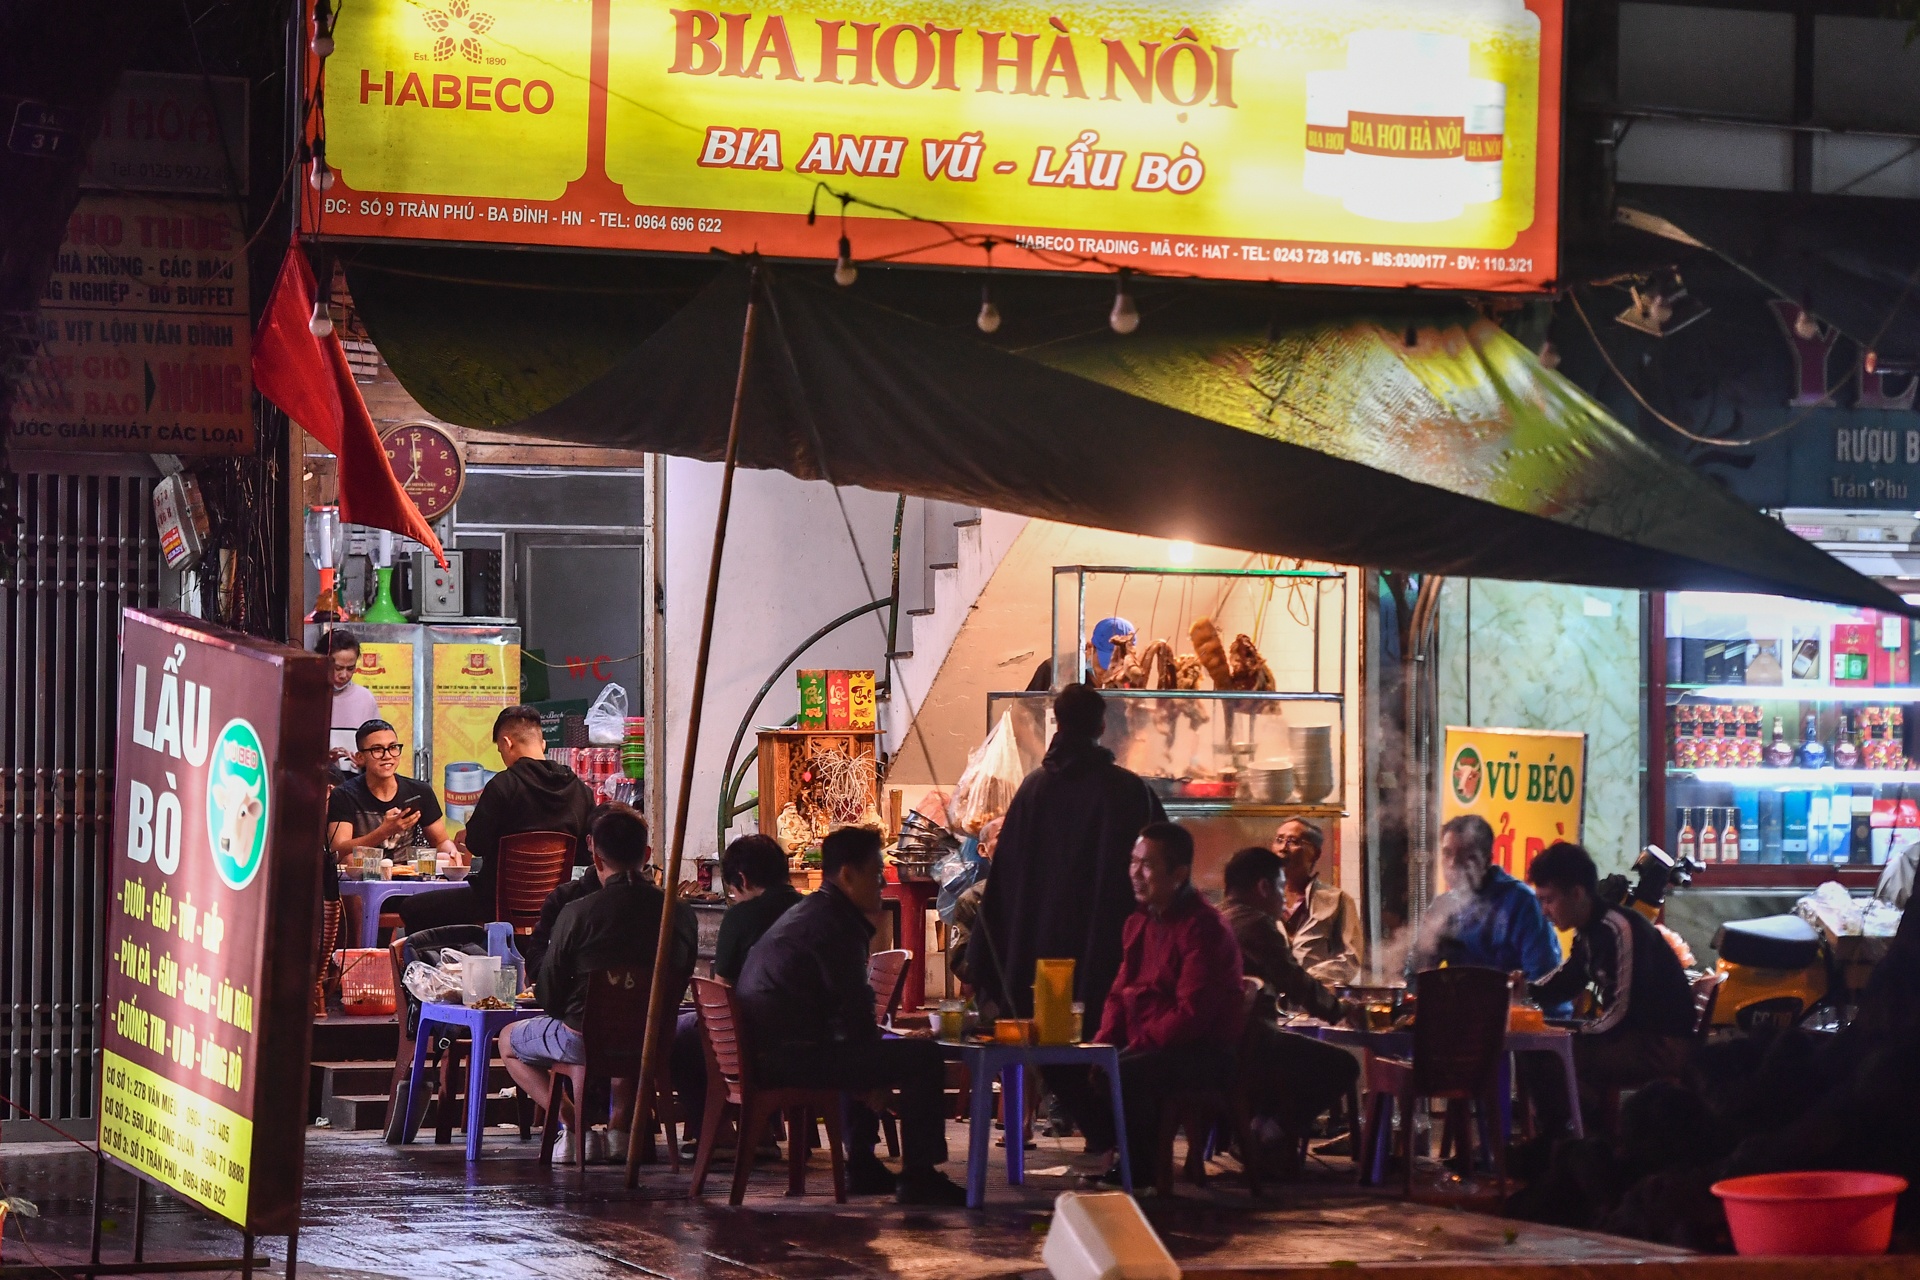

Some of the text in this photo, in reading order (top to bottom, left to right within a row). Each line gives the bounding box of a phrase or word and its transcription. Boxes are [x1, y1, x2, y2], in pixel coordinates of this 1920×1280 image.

[414, 52, 507, 67] Est. 1890
[668, 8, 1240, 123] BIA HƠI HÀ NỘI
[359, 70, 555, 115] HABECO
[1308, 130, 1345, 151] BIA HƠI
[1350, 120, 1461, 155] BIA HƠI HÀ NỘI
[1467, 136, 1483, 157] HÀ
[699, 126, 783, 169] BIA
[800, 131, 907, 175] ANH
[922, 131, 986, 180] VŨ
[1029, 130, 1125, 191] LẨU
[1133, 142, 1205, 194] BÒ
[70, 212, 233, 251] HO THUÊ
[325, 198, 351, 214] ĐC:
[359, 197, 382, 216] SỐ
[386, 202, 394, 216] 9
[398, 200, 439, 219] TRẦN
[443, 202, 474, 220] PHÚ
[487, 207, 509, 221] BA
[512, 205, 548, 223] ĐÌNH
[561, 211, 582, 225] HN
[599, 212, 630, 228] TEL:
[635, 214, 666, 229] 0964
[670, 216, 694, 231] 696
[698, 218, 722, 233] 622
[160, 255, 192, 278] CÁC
[1015, 234, 1074, 252] HABECO
[1078, 237, 1139, 255] TRADING
[1150, 239, 1171, 256] MÃ
[1174, 242, 1198, 258] CK:
[1202, 244, 1230, 260] HAT
[1241, 246, 1270, 261] TEL:
[1273, 247, 1303, 263] 0243
[1307, 249, 1329, 264] 728
[1332, 250, 1361, 265] 1476
[1457, 254, 1480, 270] ĐV:
[70, 279, 129, 305] NGHIỆP
[177, 286, 235, 306] BUFFET
[160, 352, 243, 415] NÓNG
[58, 417, 95, 438] GIẢI
[102, 422, 152, 440] KHÁT
[158, 423, 196, 441] CÁC
[202, 428, 243, 447] LOẠI
[395, 437, 405, 446] 11
[410, 433, 422, 442] 12
[429, 437, 435, 446] 1
[1837, 427, 1897, 470] RƯỢU
[440, 450, 448, 460] 2
[444, 467, 452, 477] 3
[428, 497, 436, 506] 5
[439, 485, 447, 494] 4
[565, 655, 612, 682] WC
[133, 642, 211, 767] LẨU
[1486, 751, 1575, 804] VŨ BÉO
[127, 772, 182, 876] BÒ
[121, 935, 137, 979] PÍN
[137, 942, 150, 986] CÀ
[117, 994, 148, 1047] CUỐNG
[149, 1014, 166, 1056] TIM
[106, 1066, 116, 1085] CƠ
[116, 1067, 126, 1091] SỞ
[126, 1077, 132, 1094] 1:
[104, 1096, 114, 1116] CƠ
[114, 1097, 124, 1120] SỞ
[124, 1106, 131, 1125] 2:
[131, 1108, 144, 1131] 550
[145, 1116, 157, 1140] LẠC
[158, 1123, 175, 1147] LONG
[218, 1155, 226, 1174] 71
[228, 1160, 245, 1184] 8888
[103, 1126, 113, 1146] CƠ
[113, 1128, 122, 1151] SỞ
[122, 1136, 128, 1155] 3:
[130, 1137, 140, 1160] SỐ
[140, 1143, 145, 1163] 9
[163, 1160, 177, 1180] PHÚ
[182, 1169, 198, 1193] 0964
[200, 1178, 212, 1199] 696
[213, 1185, 227, 1207] 622
